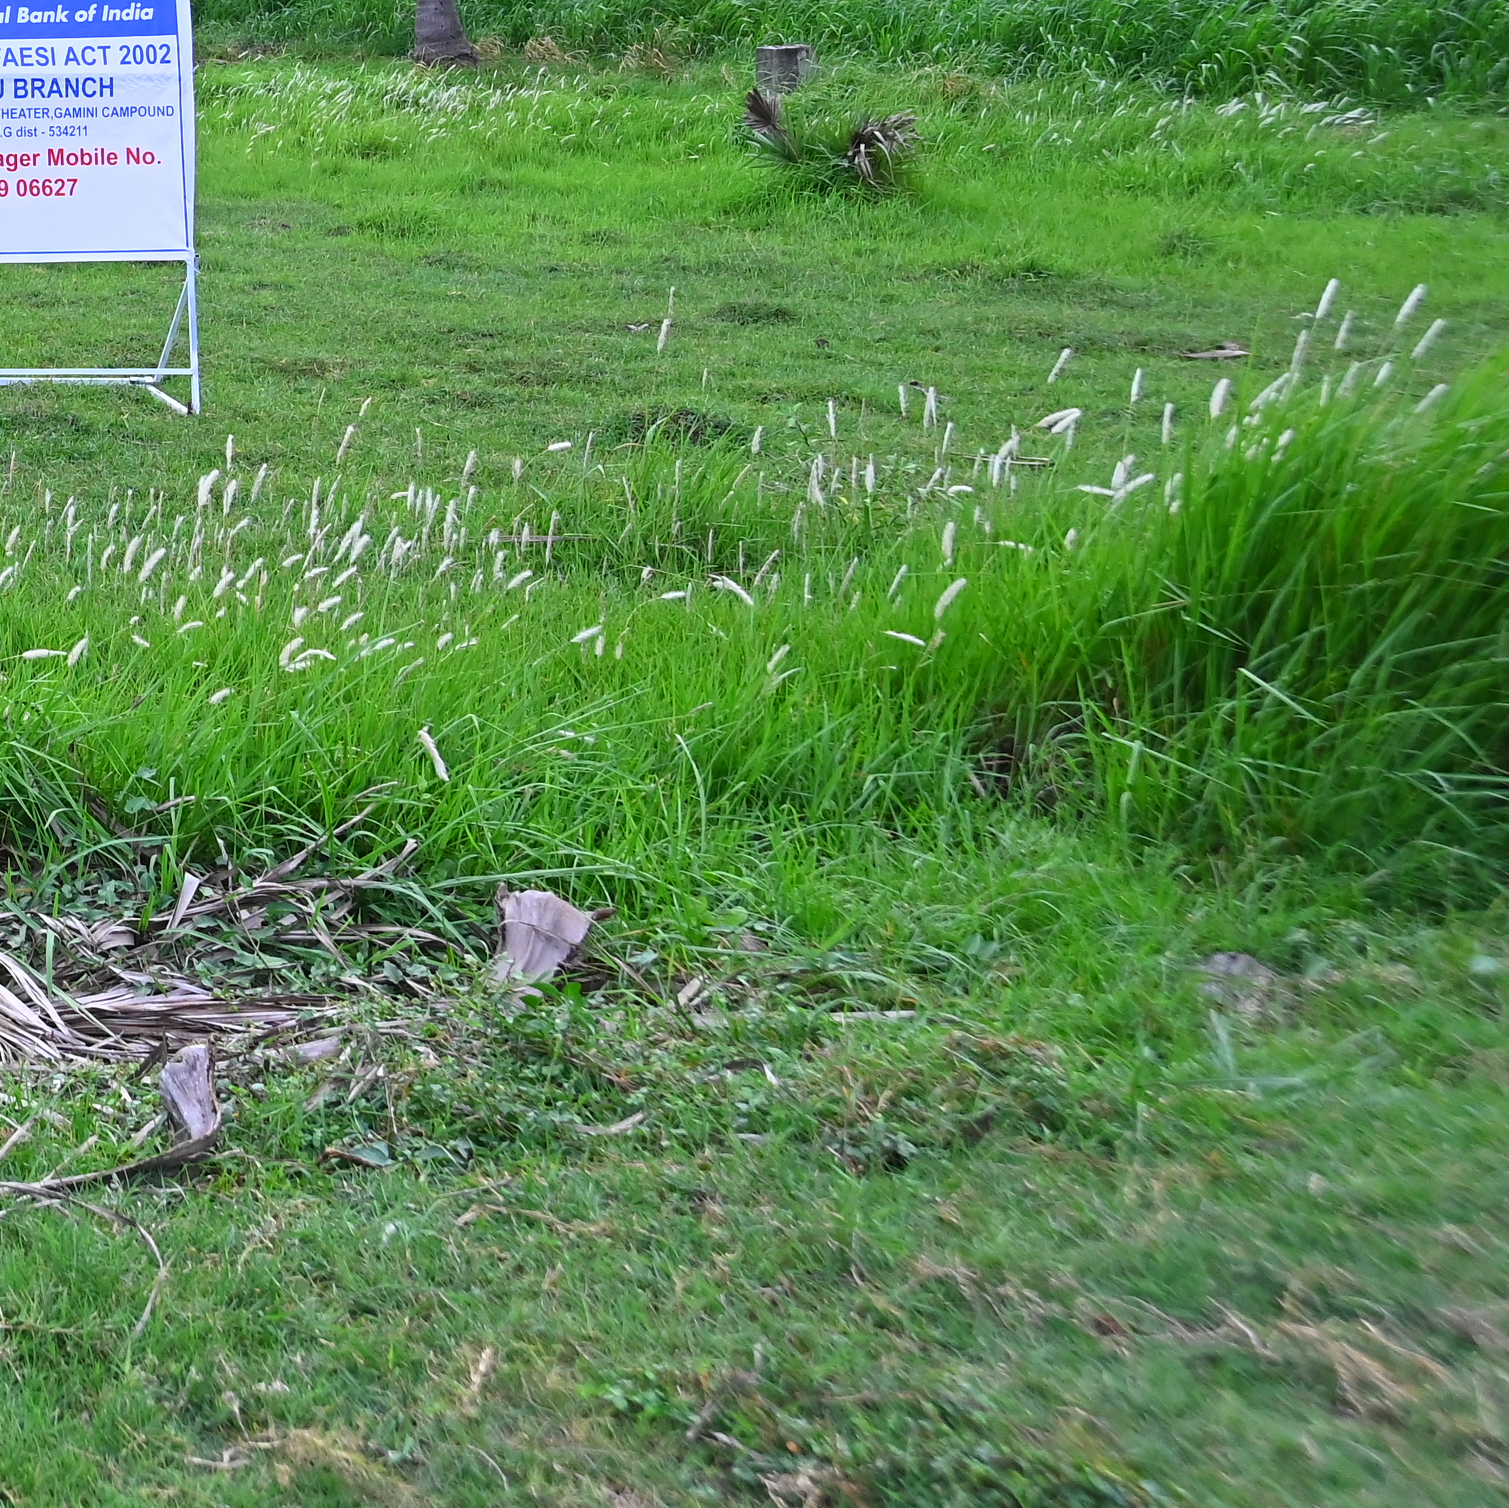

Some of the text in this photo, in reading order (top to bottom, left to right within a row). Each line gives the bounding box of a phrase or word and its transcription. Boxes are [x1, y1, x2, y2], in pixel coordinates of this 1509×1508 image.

[16, 4, 69, 24] Bank
[74, 3, 98, 23] of
[101, 2, 154, 22] India
[64, 45, 111, 66] ACT
[118, 43, 171, 65] 2002
[13, 76, 114, 99] BRANCH
[101, 105, 175, 118] CAMPOUND
[15, 126, 38, 138] dist
[48, 125, 89, 137] 534211
[47, 147, 119, 167] Mobile
[126, 147, 162, 166] No.
[16, 178, 79, 197] 06627
